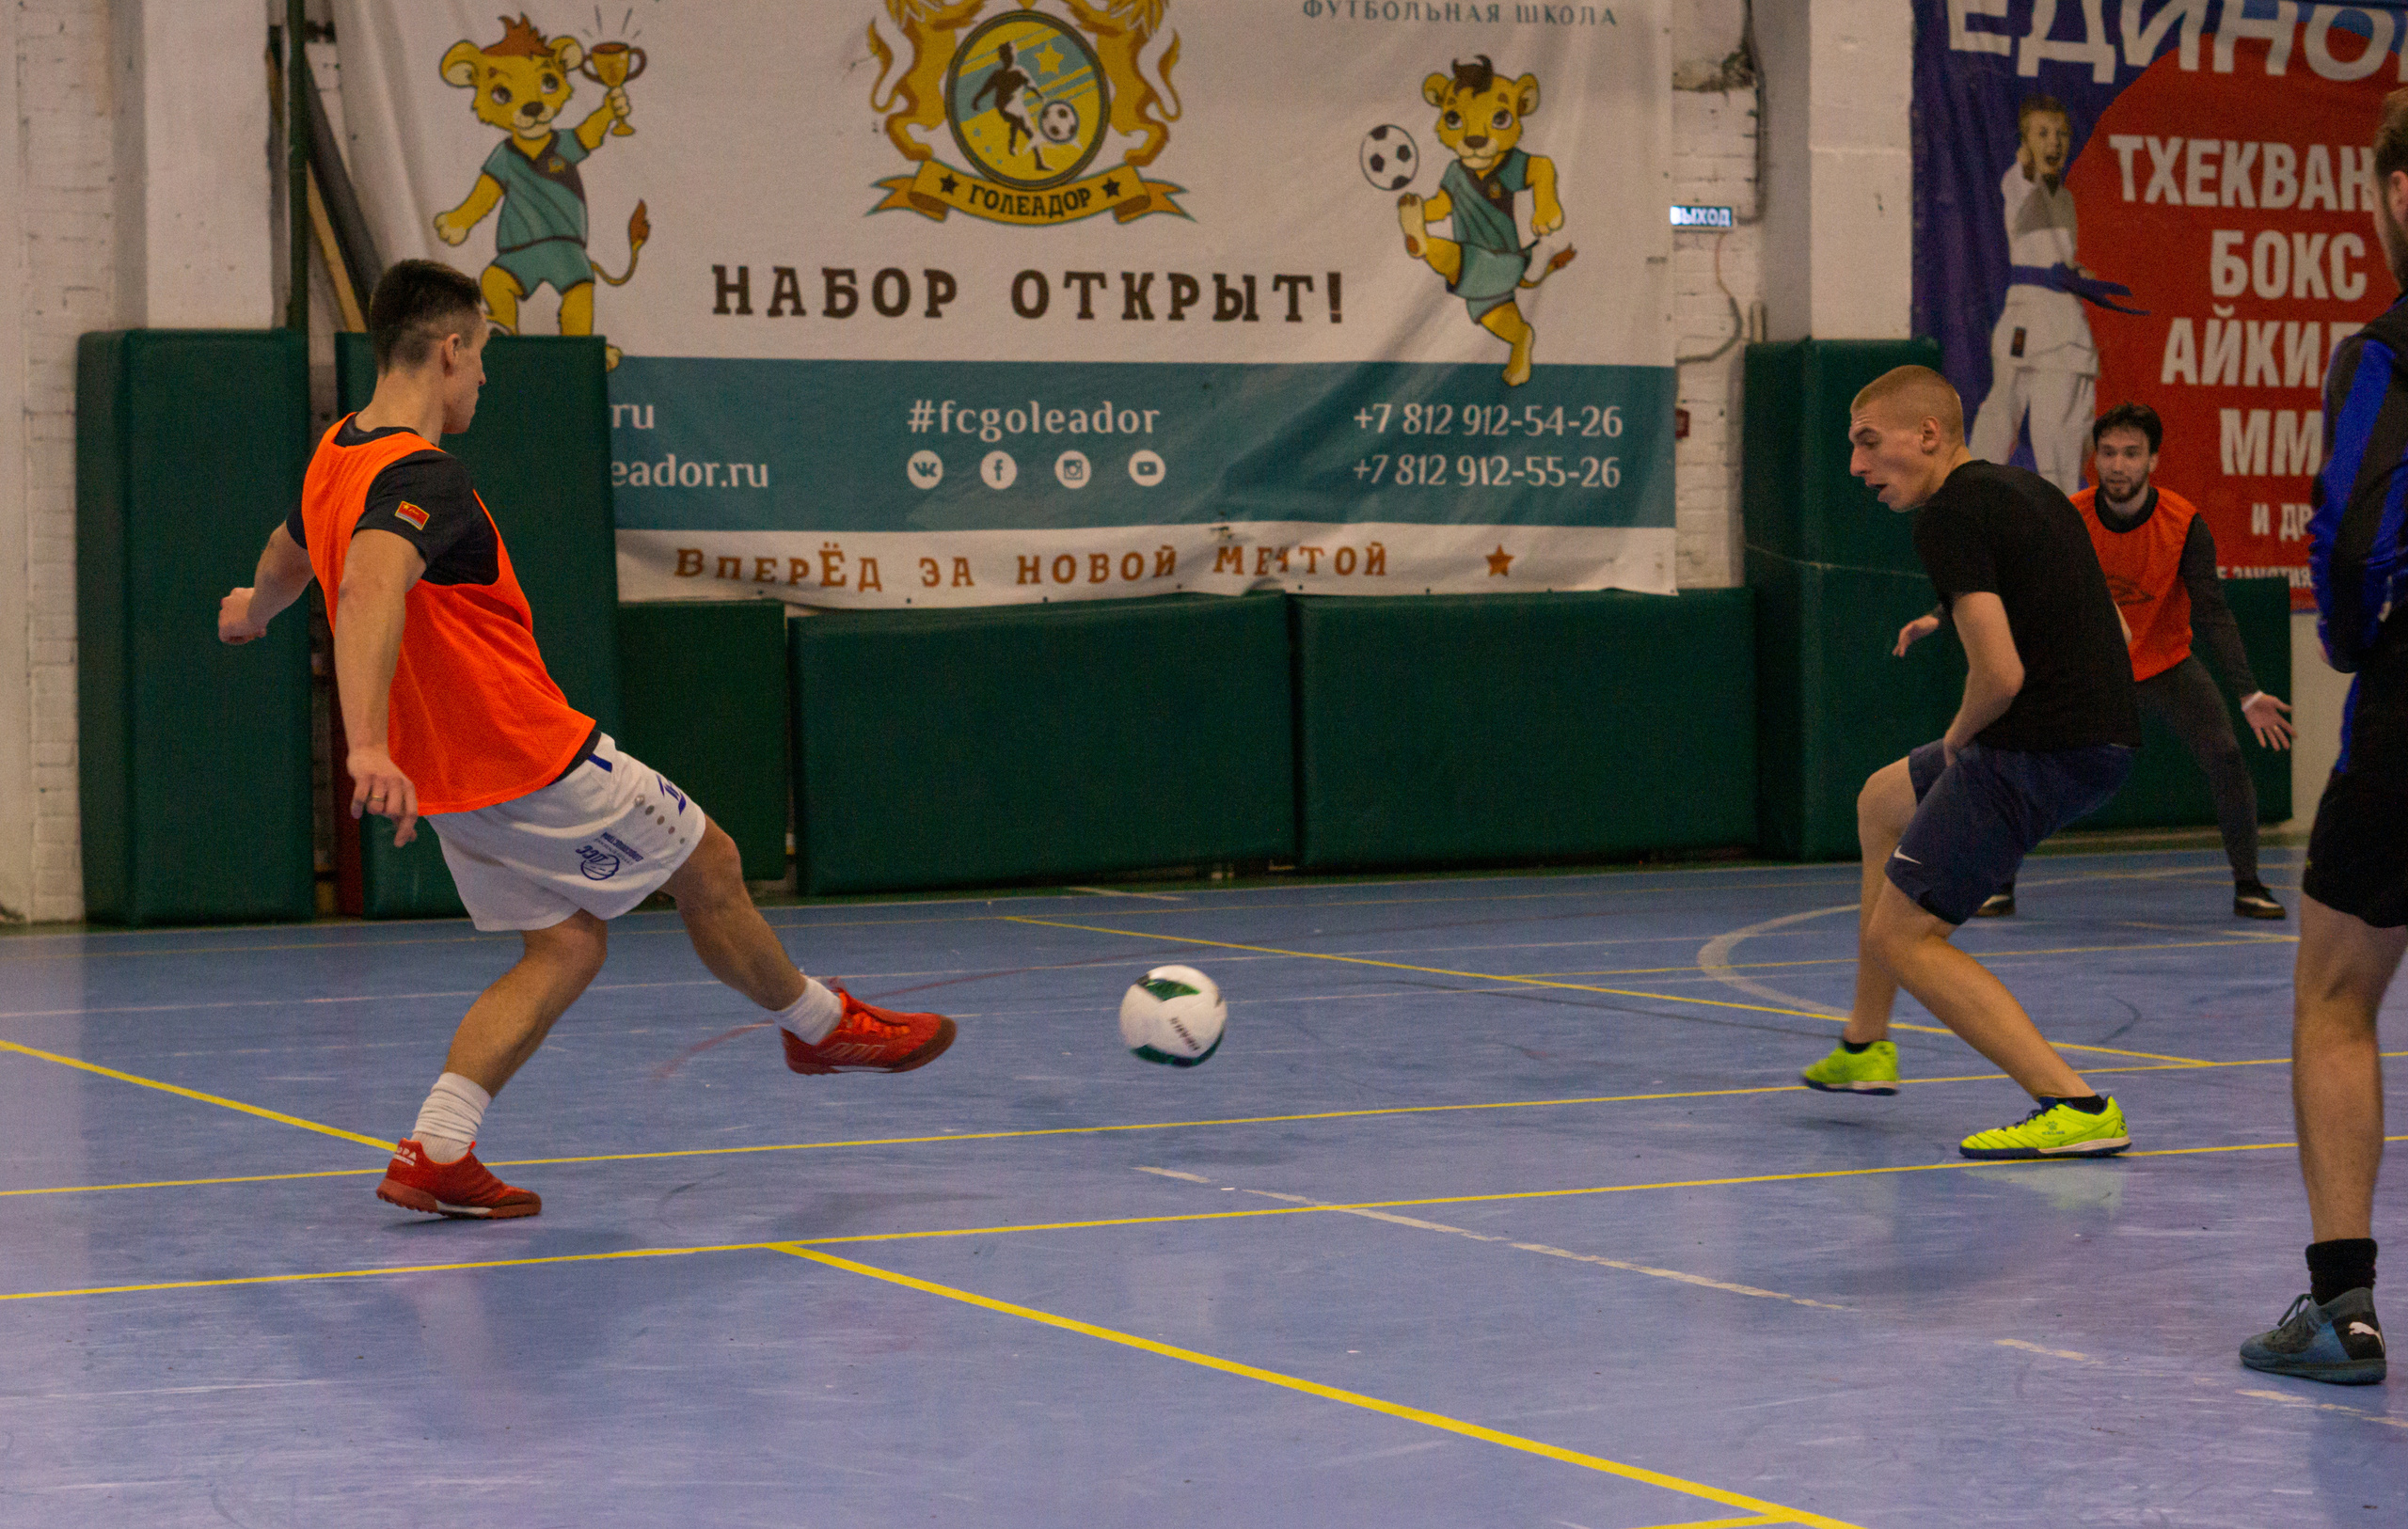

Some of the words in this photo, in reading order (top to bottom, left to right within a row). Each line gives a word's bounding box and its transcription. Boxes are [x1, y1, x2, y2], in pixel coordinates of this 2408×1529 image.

[1303, 0, 1500, 24] ФУТБОЛЬНАЯ
[1514, 4, 1617, 26] ШКОЛА
[1948, 0, 2408, 84] ЕДИНО
[970, 184, 1091, 217] ГОЛЕАДОР
[2210, 229, 2367, 301] БОКС
[711, 264, 958, 319] НАБОР
[1010, 269, 1342, 324] ОТКРЫТ!
[907, 399, 1161, 443] #fcgoleador
[1354, 402, 1393, 433] +7
[1402, 402, 1453, 434] 812
[1463, 404, 1624, 438] 912-54-26
[1353, 453, 1390, 484] +7
[1394, 453, 1447, 485] 812
[1456, 454, 1621, 488] 912-55-26
[2251, 503, 2270, 536] И
[675, 542, 882, 592] ВПЕРЁД
[919, 557, 974, 588] ЗА
[1016, 545, 1178, 586] НОВОЙ
[1212, 542, 1387, 577] МЕЧТОЙ
